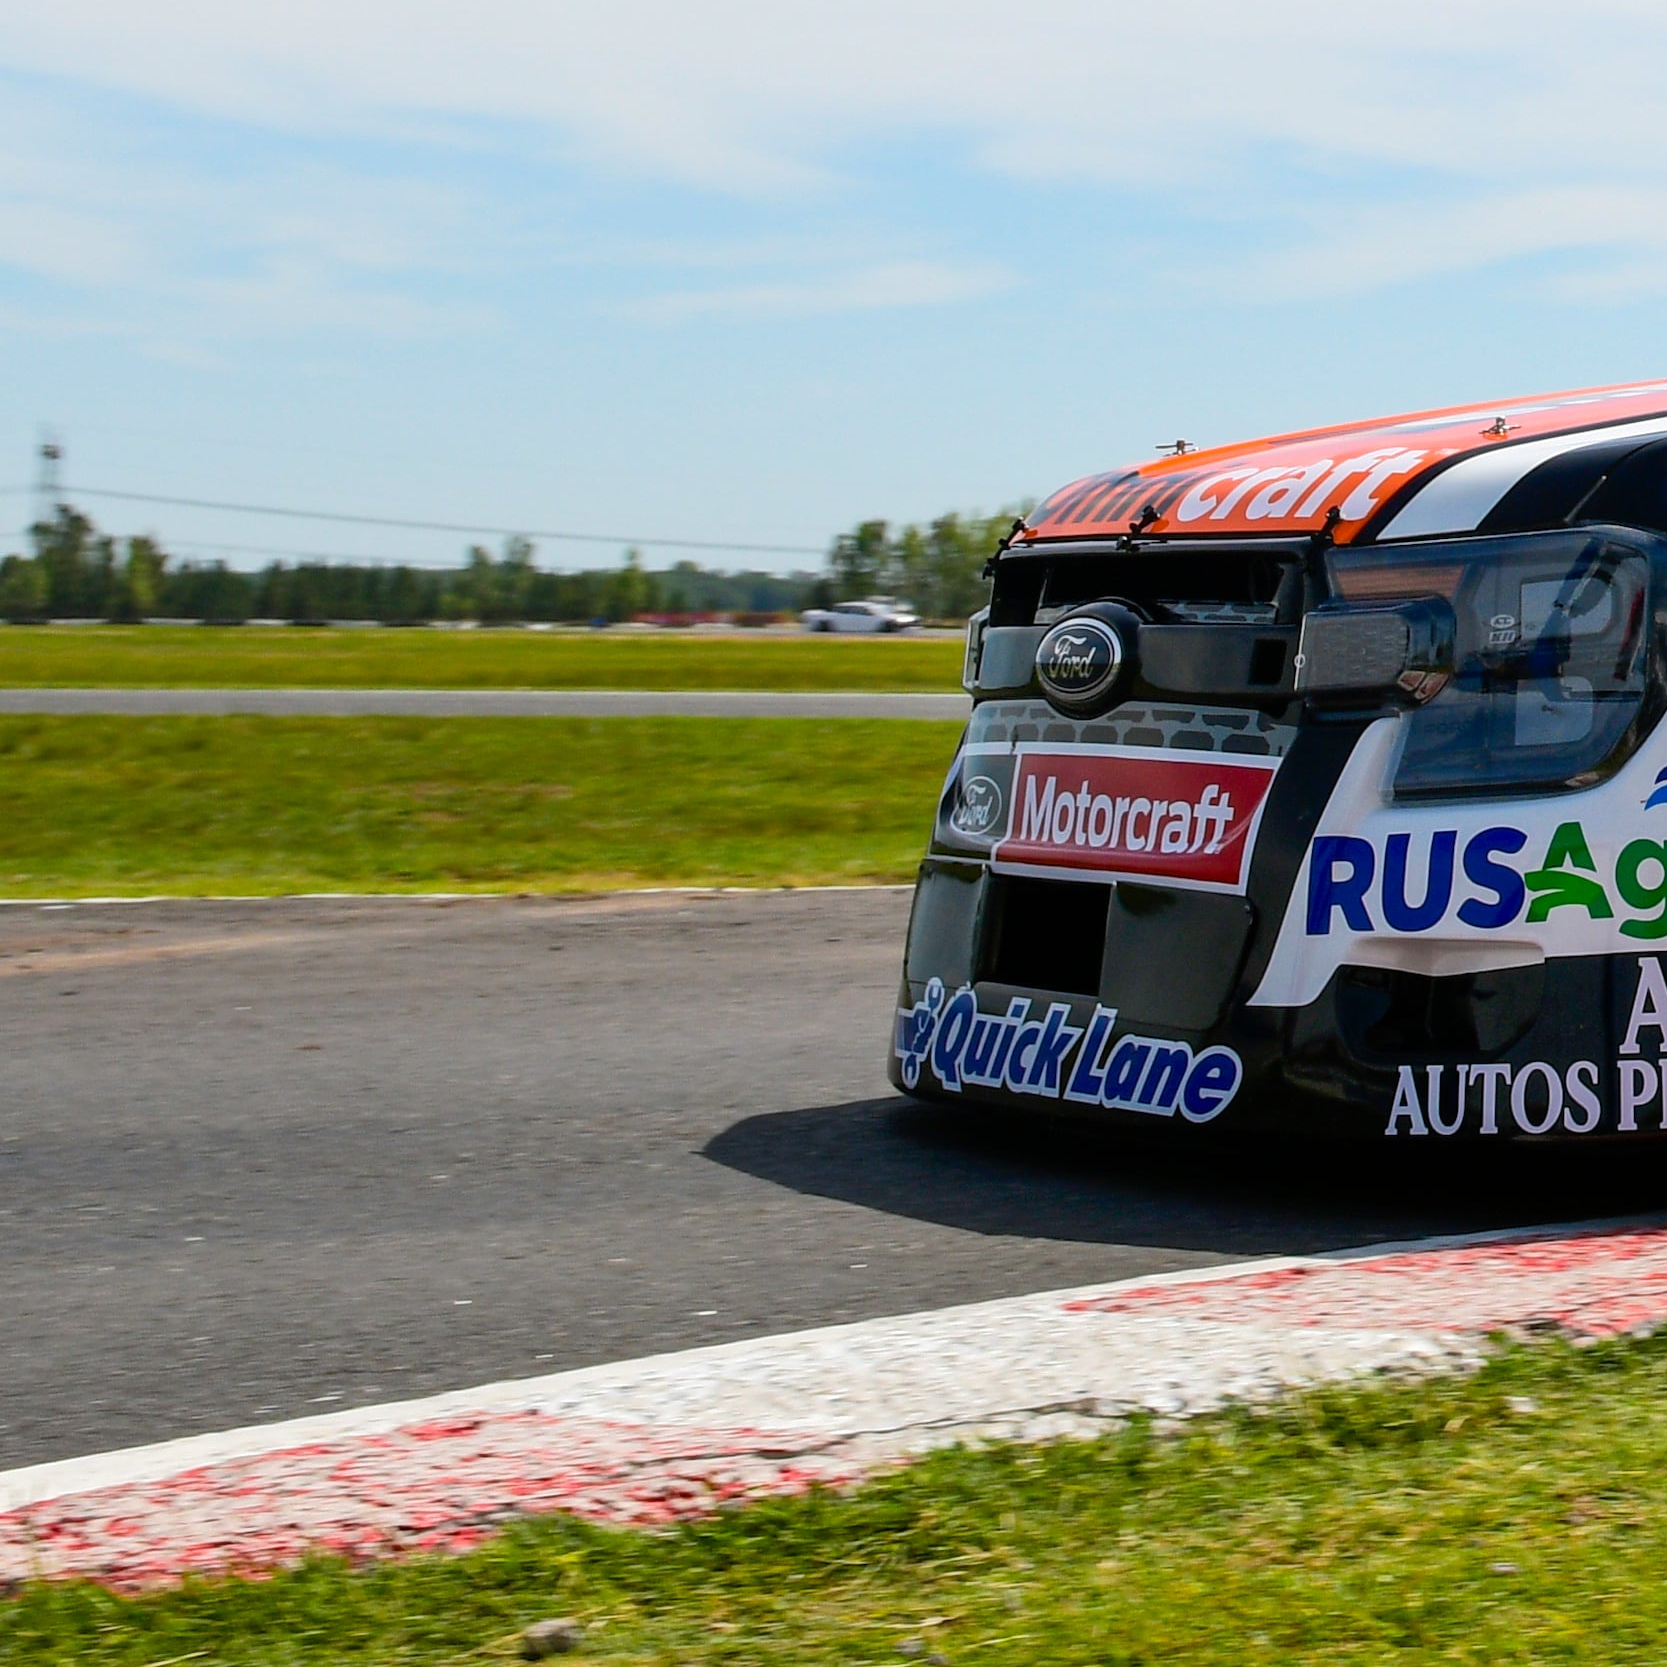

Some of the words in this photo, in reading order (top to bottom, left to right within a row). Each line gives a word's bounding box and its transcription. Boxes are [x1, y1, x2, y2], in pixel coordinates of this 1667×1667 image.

[1049, 634, 1097, 680] Ford
[958, 784, 994, 826] Ford
[1019, 774, 1235, 855] Motorcraft
[932, 989, 1084, 1097] Quick
[1063, 1006, 1243, 1123] Lane
[1384, 1059, 1601, 1136] AUTOS
